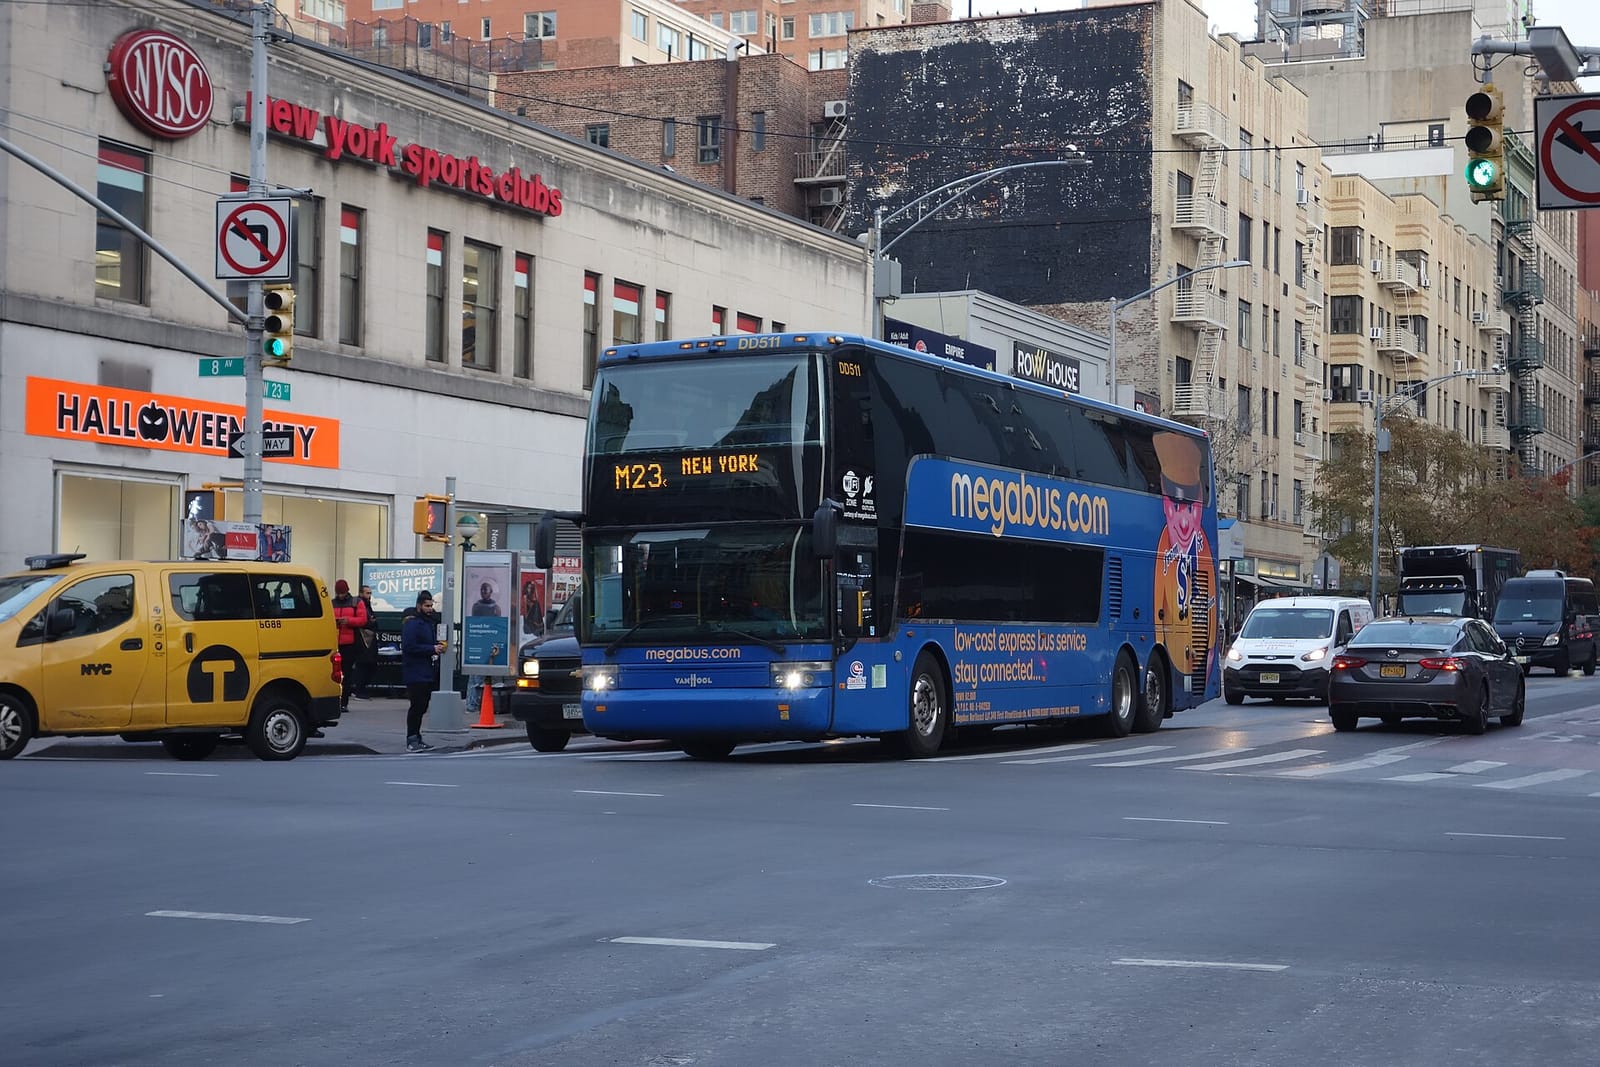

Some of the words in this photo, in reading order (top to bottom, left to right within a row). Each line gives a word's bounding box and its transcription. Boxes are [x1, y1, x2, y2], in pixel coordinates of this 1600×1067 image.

[134, 42, 203, 124] NYSC
[324, 116, 397, 167] york
[401, 143, 495, 196] sports
[495, 167, 563, 217] clubs
[737, 336, 781, 350] DD511
[945, 343, 965, 359] EMPIRE
[211, 360, 219, 375] 8
[225, 360, 233, 368] AV
[838, 361, 862, 377] DD511
[1017, 349, 1047, 379] ROW
[1047, 359, 1078, 391] HOUSE
[271, 383, 282, 398] 23
[264, 439, 285, 450] WAY
[681, 457, 712, 475] NEW
[718, 454, 759, 472] YORK
[951, 471, 1109, 537] megabus.com
[369, 572, 395, 581] SERVICE
[396, 567, 436, 578] STANDARDS
[377, 580, 399, 594] ON
[402, 576, 436, 592] FLEET.
[381, 632, 402, 642] Stree
[954, 627, 996, 652] low-cost
[998, 632, 1035, 656] express
[1037, 629, 1055, 651] bus
[1056, 629, 1087, 651] service
[645, 647, 741, 663] megabus.com
[81, 663, 112, 676] NYC
[954, 659, 978, 689] stay
[201, 660, 236, 701] T
